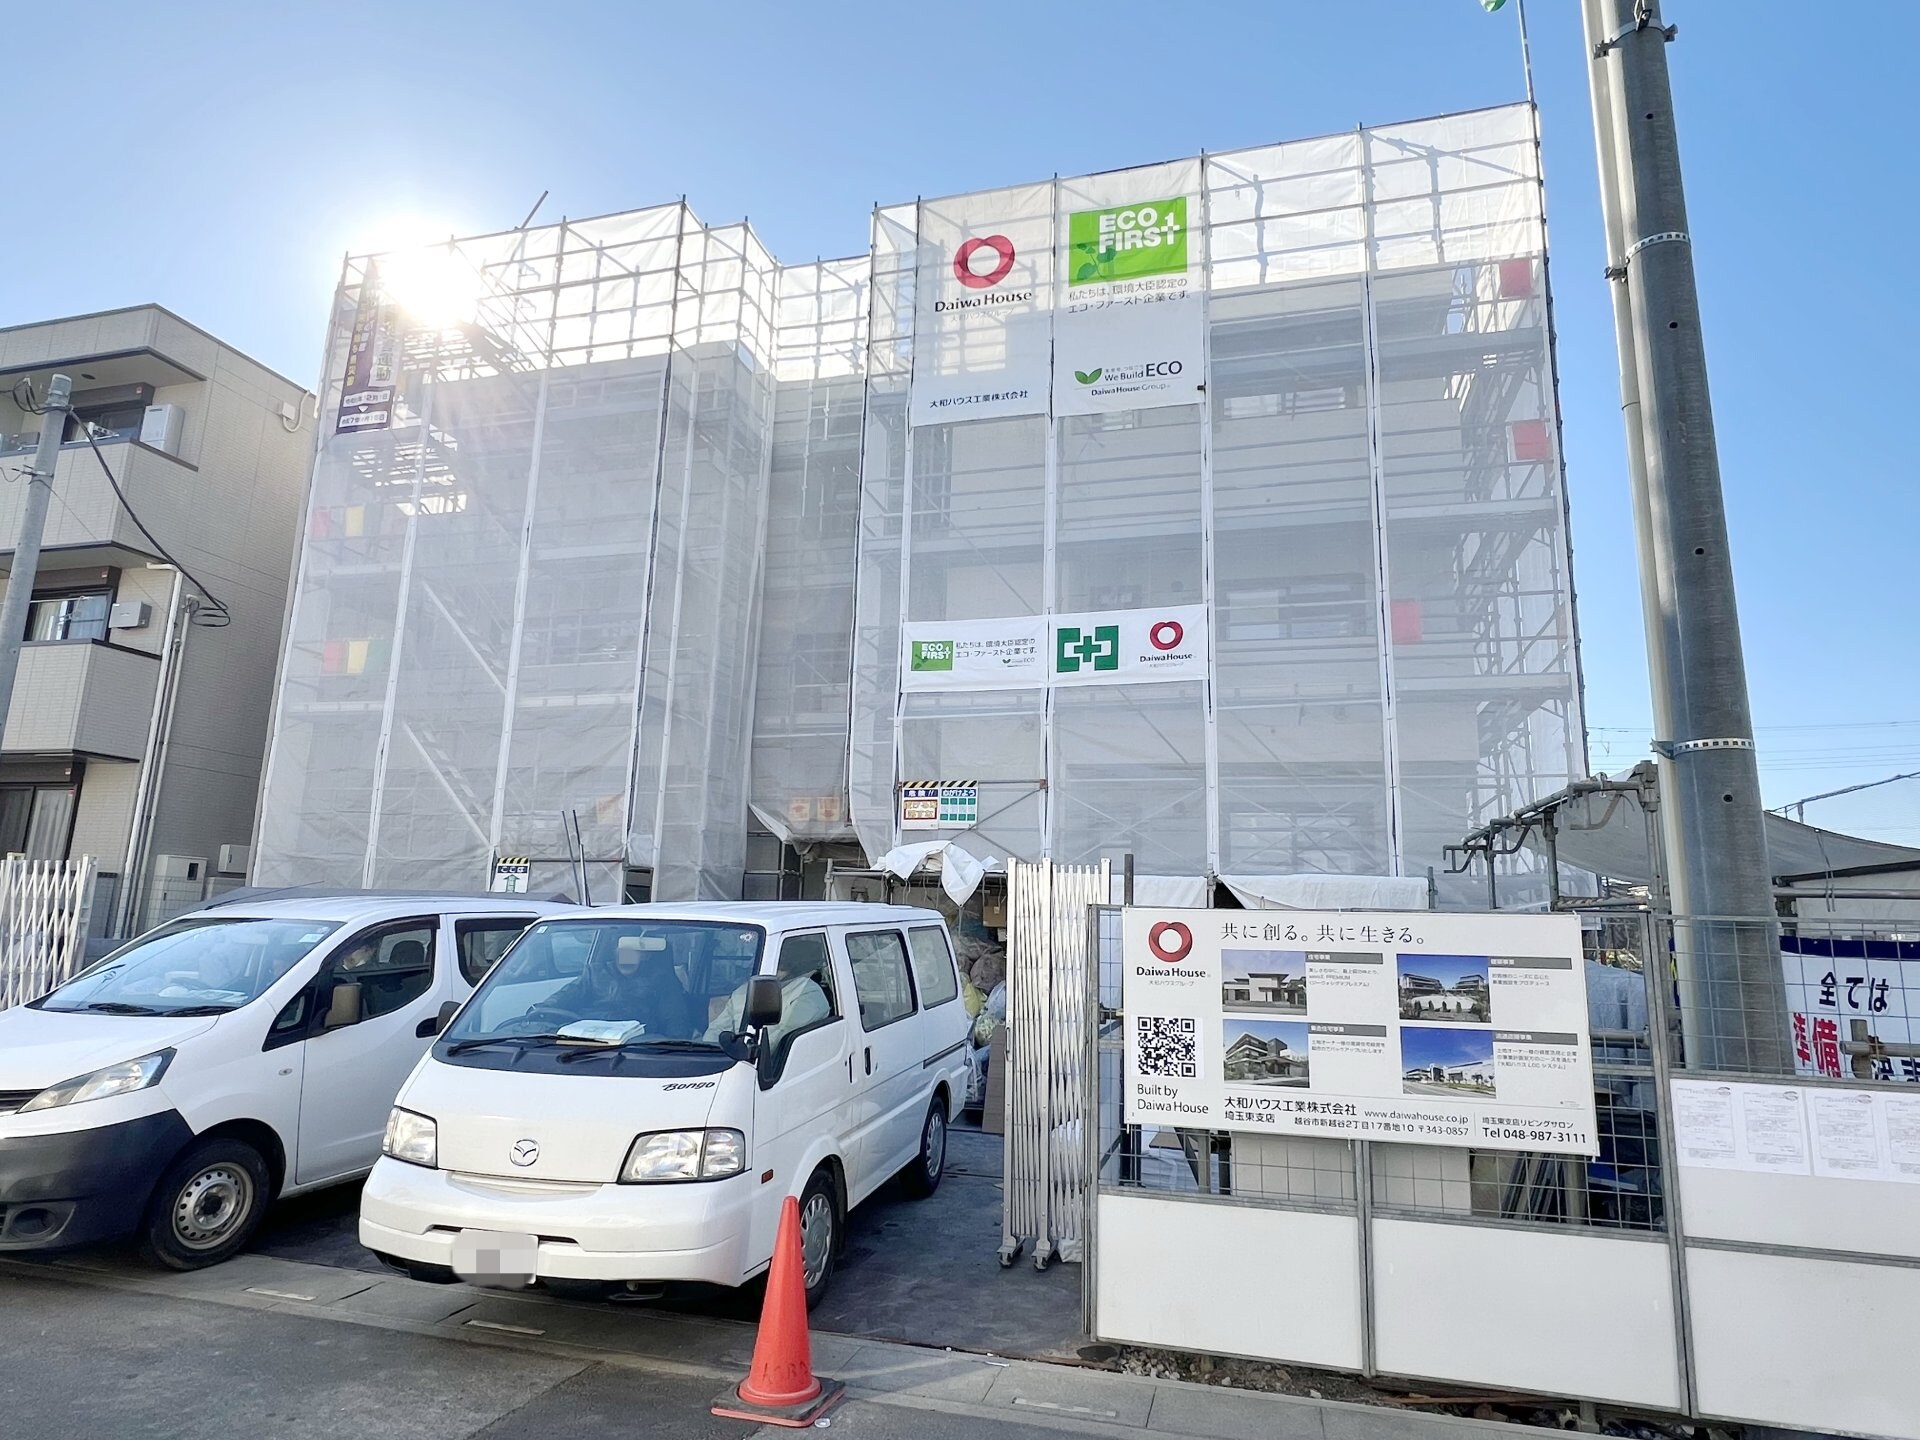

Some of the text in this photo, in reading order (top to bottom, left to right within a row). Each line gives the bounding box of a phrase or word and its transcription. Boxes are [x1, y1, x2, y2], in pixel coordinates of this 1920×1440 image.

[1098, 207, 1157, 233] ECO
[935, 291, 1033, 313] Daiwa House
[1105, 373, 1119, 382] We
[1120, 370, 1144, 380] Build
[1146, 361, 1183, 377] ECO
[1091, 382, 1167, 396] Daiwa House Group
[929, 389, 1029, 409] 大和ハウス工業株式会社
[1139, 654, 1166, 662] Daiwa
[1136, 966, 1206, 978] Daiwa House
[1818, 971, 1890, 1013] 全ては
[662, 1080, 715, 1092] Bongo
[1137, 1083, 1178, 1099] Built by
[1137, 1099, 1209, 1114] Daiwa House
[1224, 1096, 1469, 1124] 大和ハウス工業株式会社 www.daiwahouse.co.jp
[1224, 1111, 1276, 1124] 埼玉東支店
[1482, 1116, 1574, 1129] 埼玉東支店リビングサロン
[1482, 1127, 1586, 1143] Tel 048-987-3111
